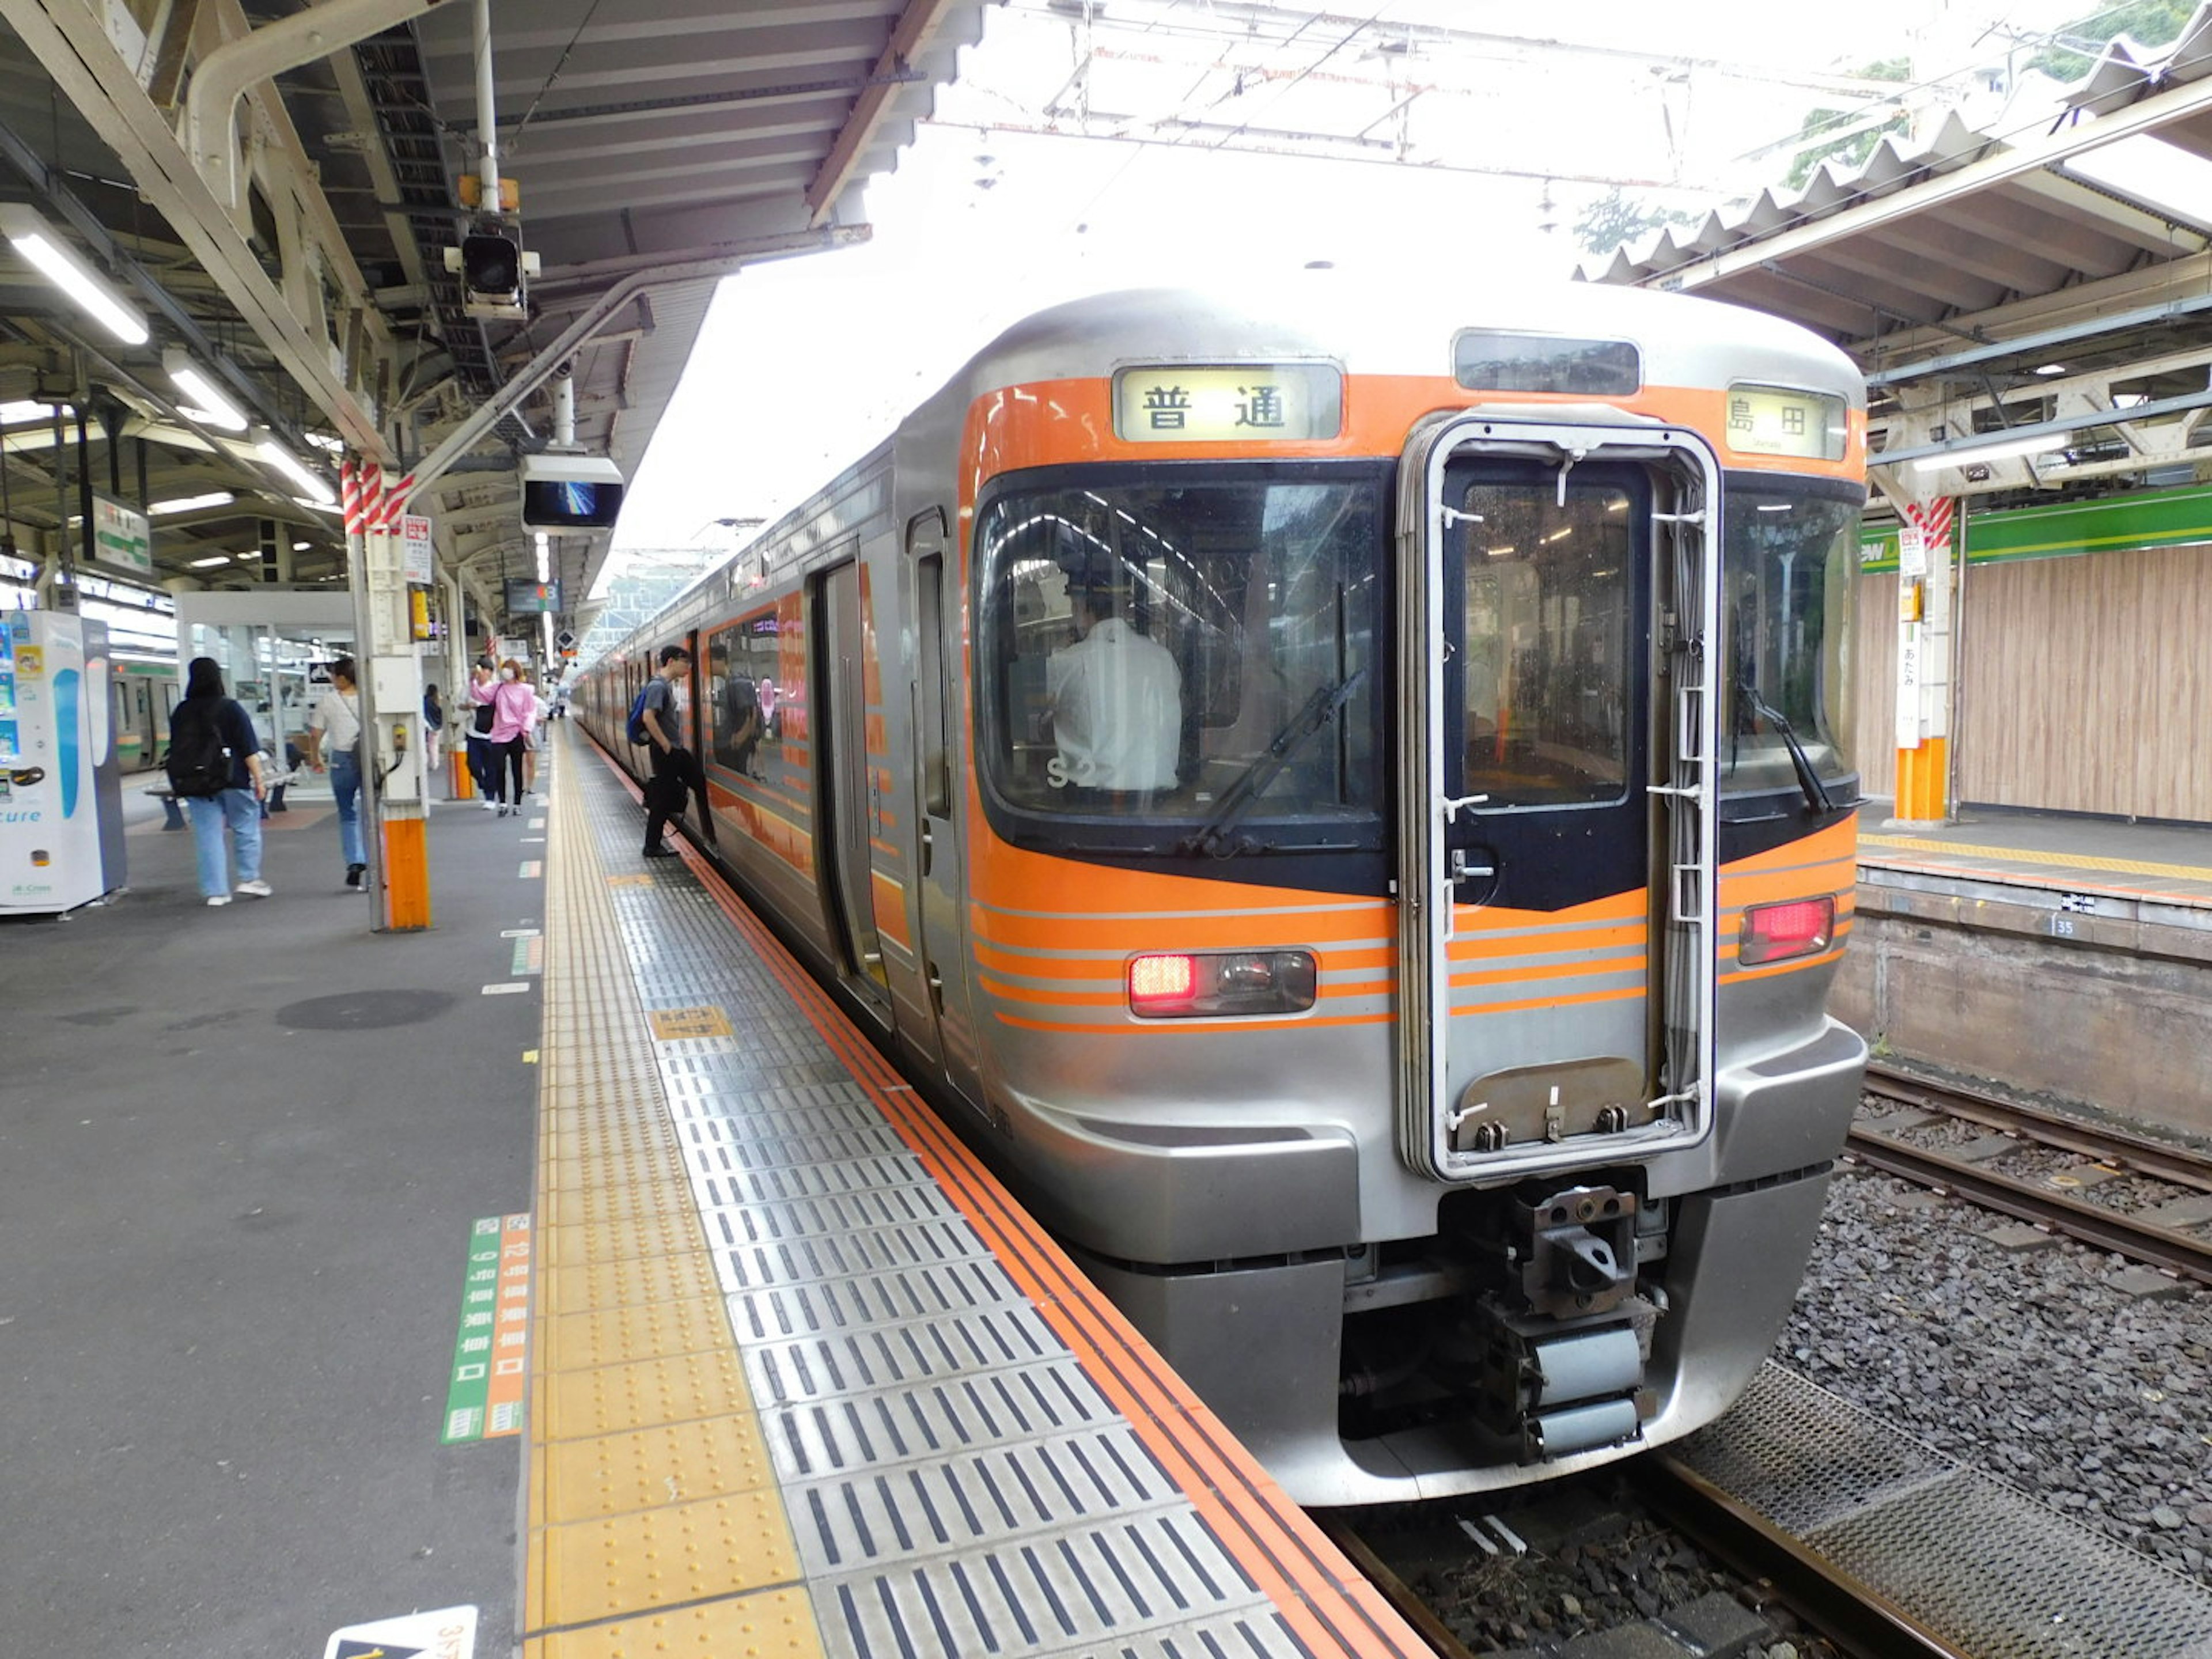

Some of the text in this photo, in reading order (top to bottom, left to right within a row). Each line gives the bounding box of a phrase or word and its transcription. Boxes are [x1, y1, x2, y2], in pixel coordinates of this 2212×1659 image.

[1142, 385, 1286, 429] 普通
[1728, 397, 1806, 435] 島田
[1904, 649, 1915, 686] あたみ
[2058, 921, 2074, 934] 35
